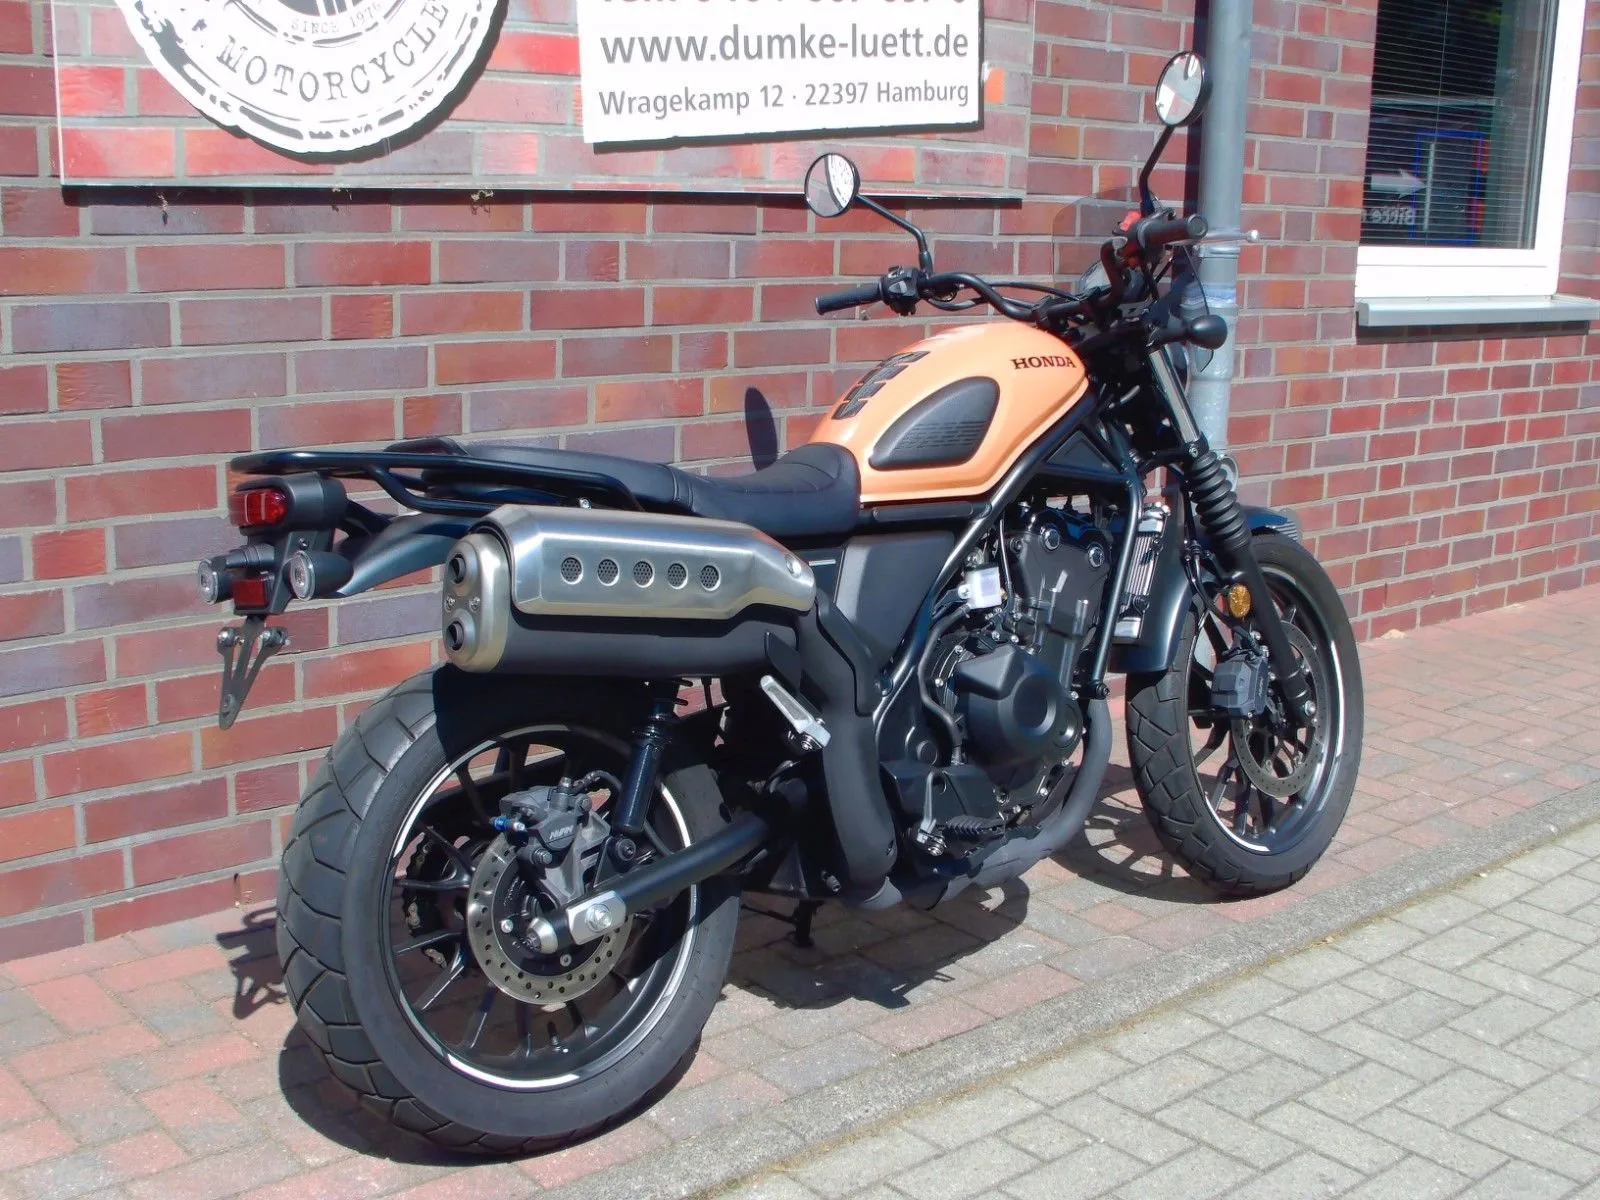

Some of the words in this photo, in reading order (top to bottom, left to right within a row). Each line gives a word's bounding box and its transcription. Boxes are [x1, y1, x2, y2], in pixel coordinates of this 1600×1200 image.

[291, 20, 339, 35] SINCE
[600, 23, 969, 64] www.dumke-luett.de
[216, 0, 449, 102] MOTORCYCLE
[599, 86, 750, 120] Wragekamp
[760, 85, 784, 108] 12
[805, 82, 868, 106] 22397
[877, 80, 969, 107] Hamburg
[1011, 355, 1077, 370] HONDA
